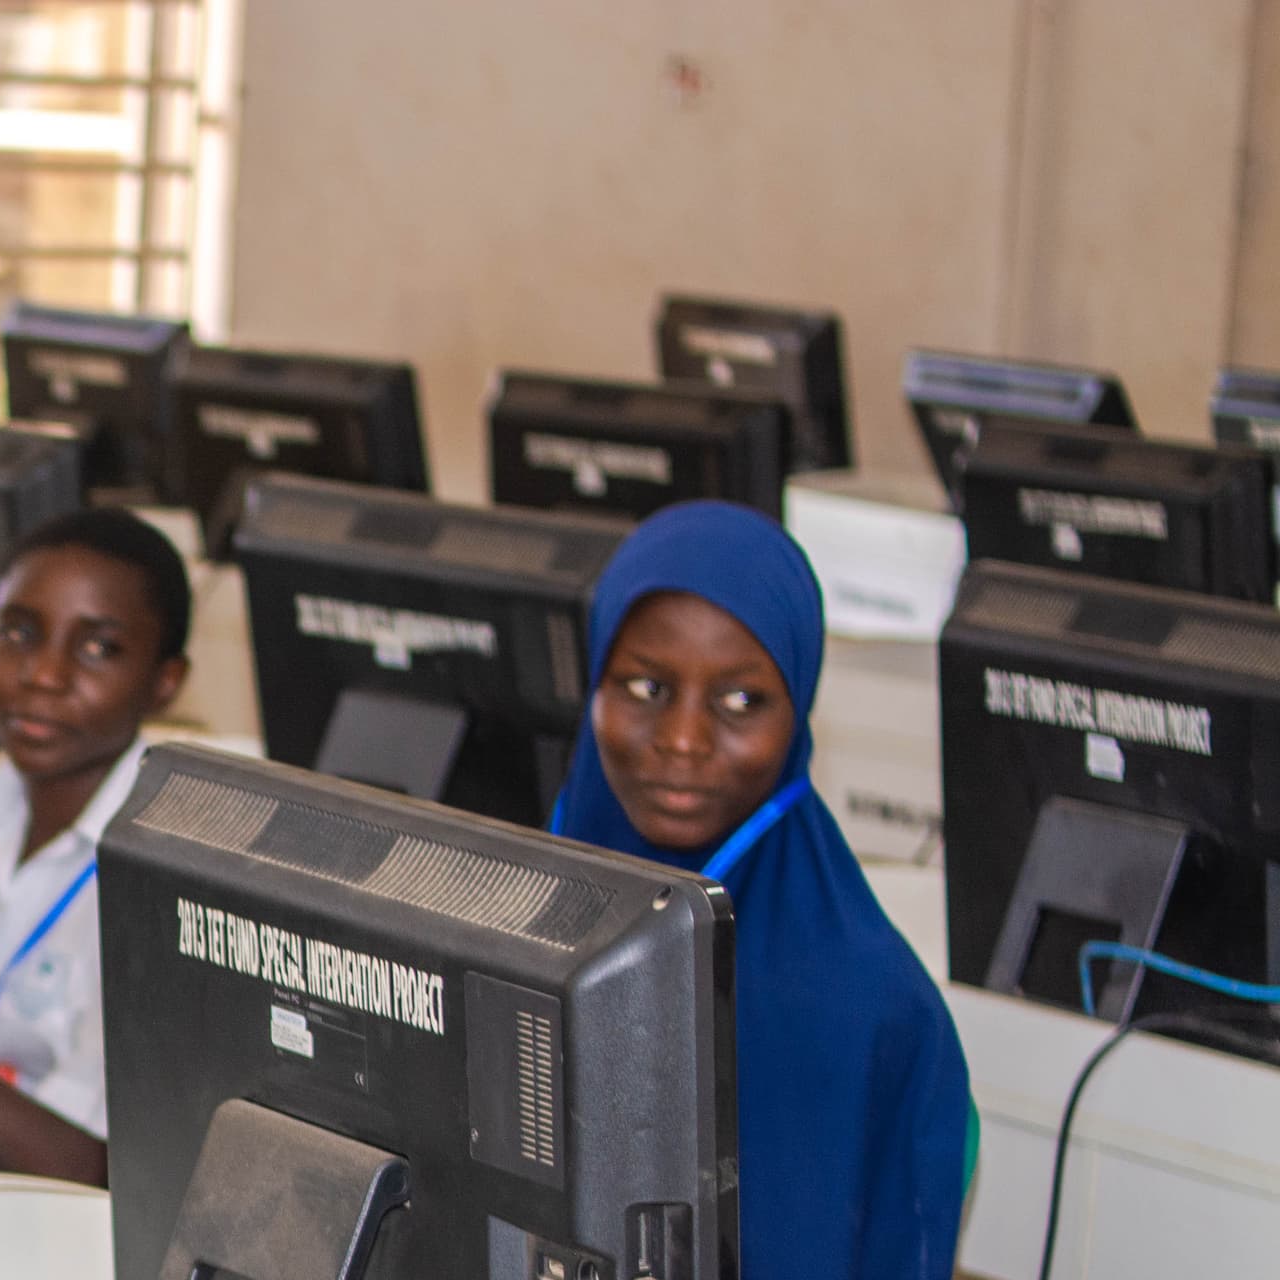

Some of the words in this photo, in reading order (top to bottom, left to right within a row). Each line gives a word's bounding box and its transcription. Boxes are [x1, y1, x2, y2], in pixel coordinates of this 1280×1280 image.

[178, 897, 206, 961] 2013
[206, 907, 226, 967] TET
[227, 912, 260, 979] FUND
[260, 922, 306, 991] SPECIAL
[306, 938, 391, 1020] INTERVENTION
[392, 961, 444, 1036] PROJECT
